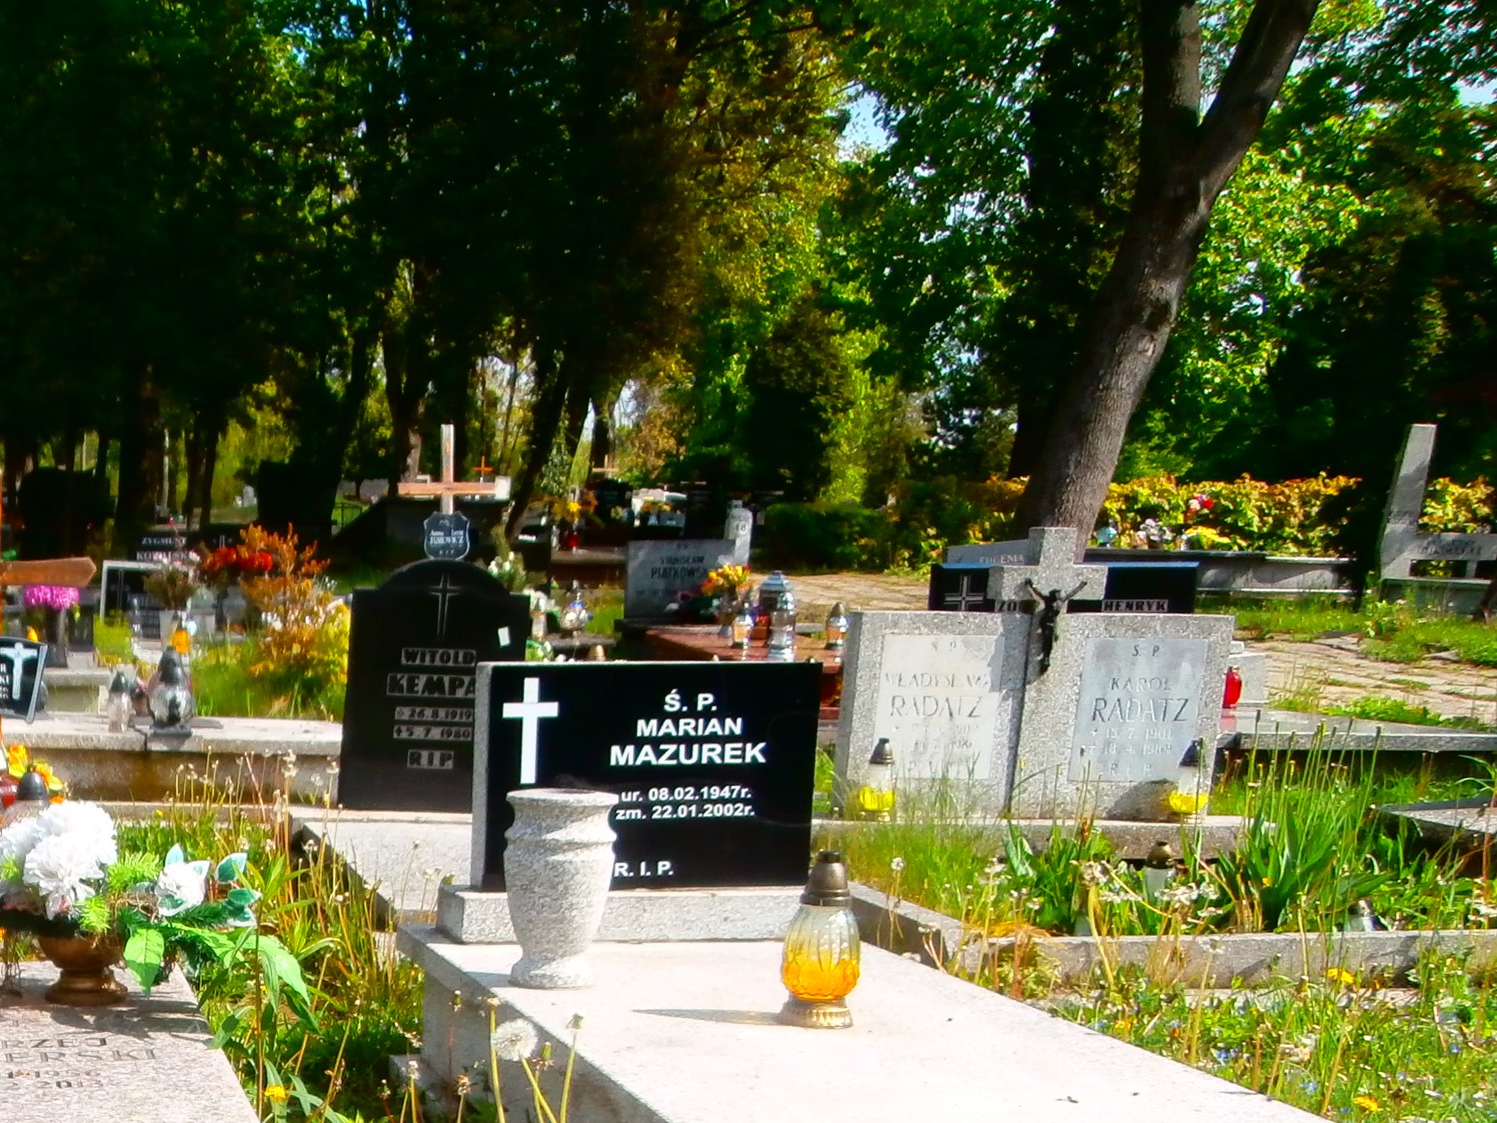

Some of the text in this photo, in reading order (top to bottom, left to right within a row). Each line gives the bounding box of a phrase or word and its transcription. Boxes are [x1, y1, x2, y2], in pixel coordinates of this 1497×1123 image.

[1104, 600, 1168, 612] HENRYK
[403, 648, 475, 666] WITOLD
[1111, 677, 1172, 692] KAROL
[663, 688, 718, 712] Ś. P.
[890, 695, 982, 719] RADATZ
[1092, 697, 1190, 723] RADATZ
[636, 717, 743, 737] MARIAN
[609, 742, 767, 766] MAZUREK
[620, 785, 752, 802] ur. 08.02.1947r.
[615, 803, 755, 820] zm. 22.01.2002r.
[613, 860, 674, 878] R. I. P.
